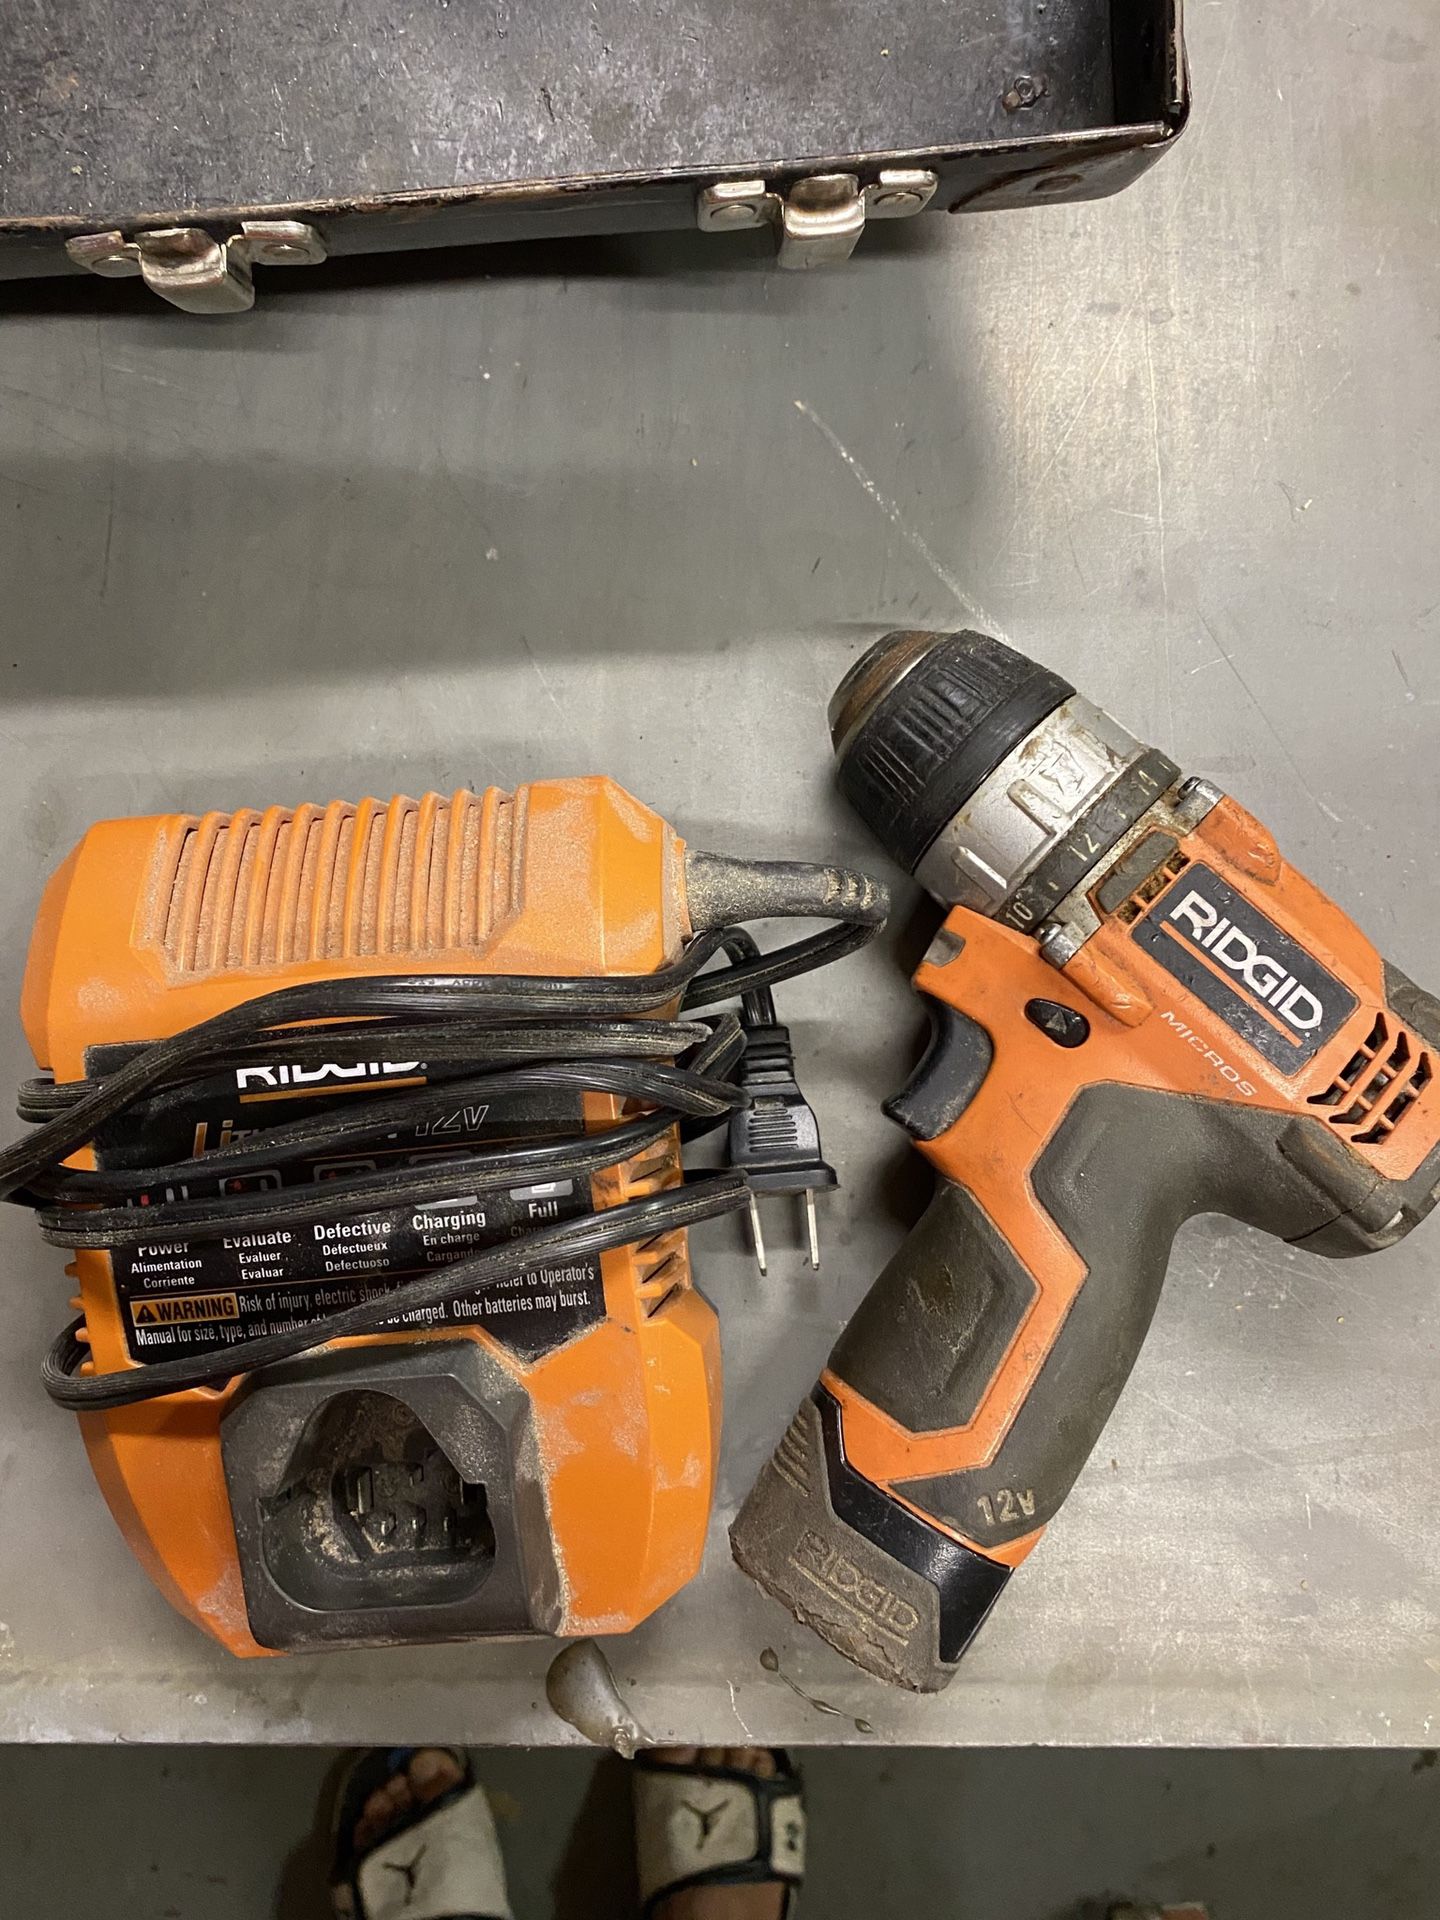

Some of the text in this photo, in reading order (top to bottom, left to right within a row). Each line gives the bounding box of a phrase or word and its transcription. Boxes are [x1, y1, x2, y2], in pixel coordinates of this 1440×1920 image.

[1169, 890, 1323, 1030] RIDGID
[528, 1201, 558, 1219] Full
[412, 1210, 486, 1231] Charging
[223, 1230, 292, 1249] Evaluate
[313, 1220, 391, 1241] Defective
[423, 1231, 480, 1246] En charge
[131, 1258, 203, 1274] Alimentation
[238, 1251, 281, 1264] Evaluer
[325, 1257, 390, 1272] Defectuoso
[143, 1276, 195, 1289] Corriente
[241, 1267, 284, 1280] Evaluar
[156, 1297, 235, 1321] WARNING
[239, 1294, 263, 1312] Risk
[265, 1293, 277, 1310] of
[315, 1288, 357, 1306] electric
[135, 1325, 176, 1346] Manual
[177, 1325, 192, 1343] for
[220, 1323, 246, 1343] type,
[249, 1321, 268, 1336] and
[453, 1298, 482, 1318] Other
[485, 1294, 533, 1315] batteries
[536, 1295, 557, 1312] may
[559, 1289, 590, 1310] burst.
[795, 1529, 920, 1633] RIDGID
